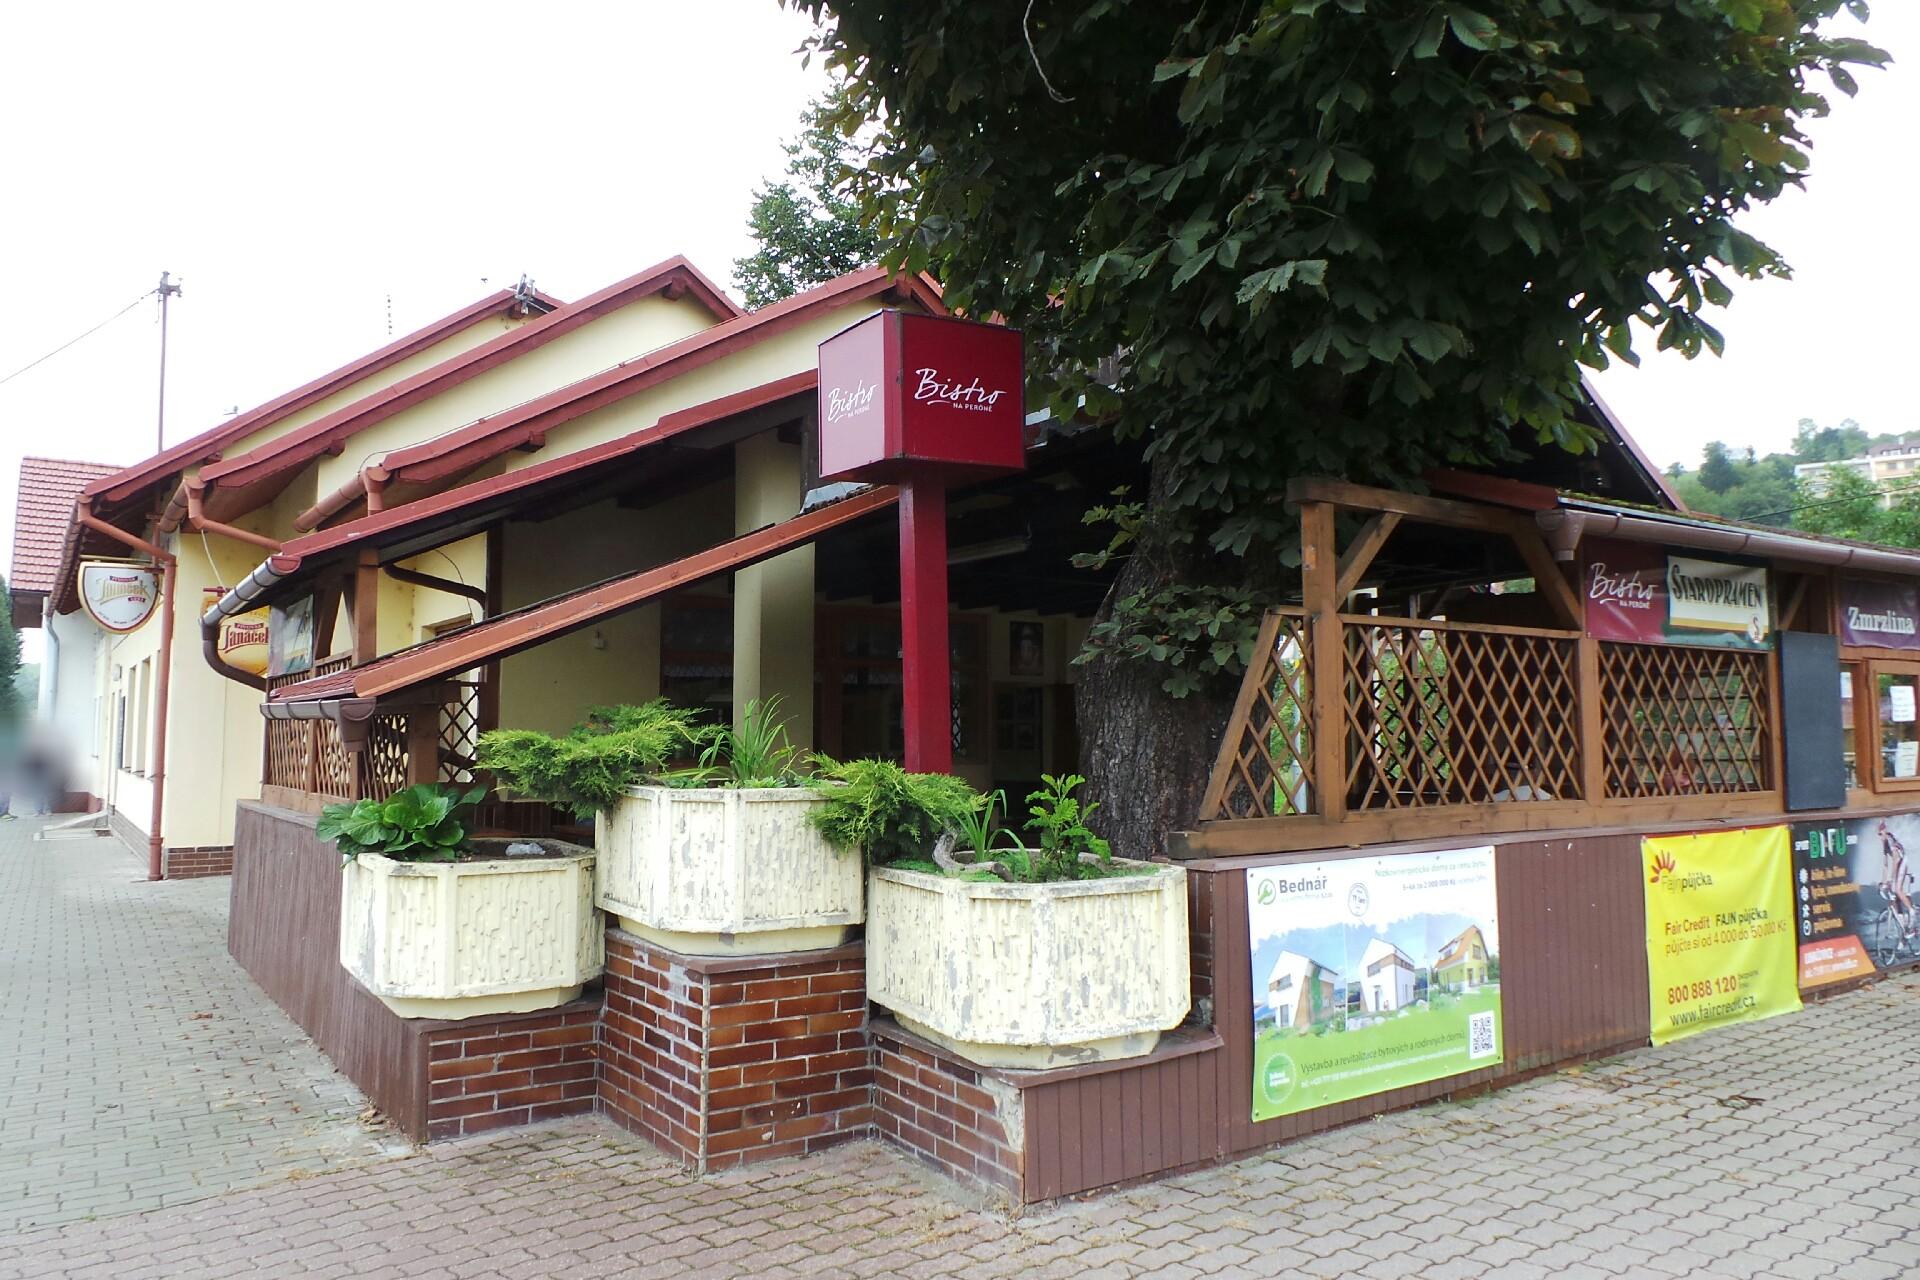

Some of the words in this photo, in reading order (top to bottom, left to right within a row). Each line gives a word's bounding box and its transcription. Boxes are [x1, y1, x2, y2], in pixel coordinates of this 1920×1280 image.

[828, 379, 879, 421] Bistro
[914, 367, 1007, 404] Bistro
[1589, 562, 1658, 599] Bistro
[1671, 564, 1763, 609] STAROPRAMEN
[1848, 606, 1915, 635] Zmrzlina
[1279, 875, 1328, 893] Bednář
[1665, 920, 1682, 936] Fair
[1683, 916, 1711, 932] Credit
[1715, 911, 1737, 927] FAJN
[1702, 936, 1713, 948] od
[1714, 932, 1719, 944] 4
[1720, 929, 1738, 944] 000
[1738, 927, 1749, 940] do
[1668, 984, 1689, 1005] 800
[1691, 980, 1713, 999] 888
[1715, 975, 1737, 993] 120
